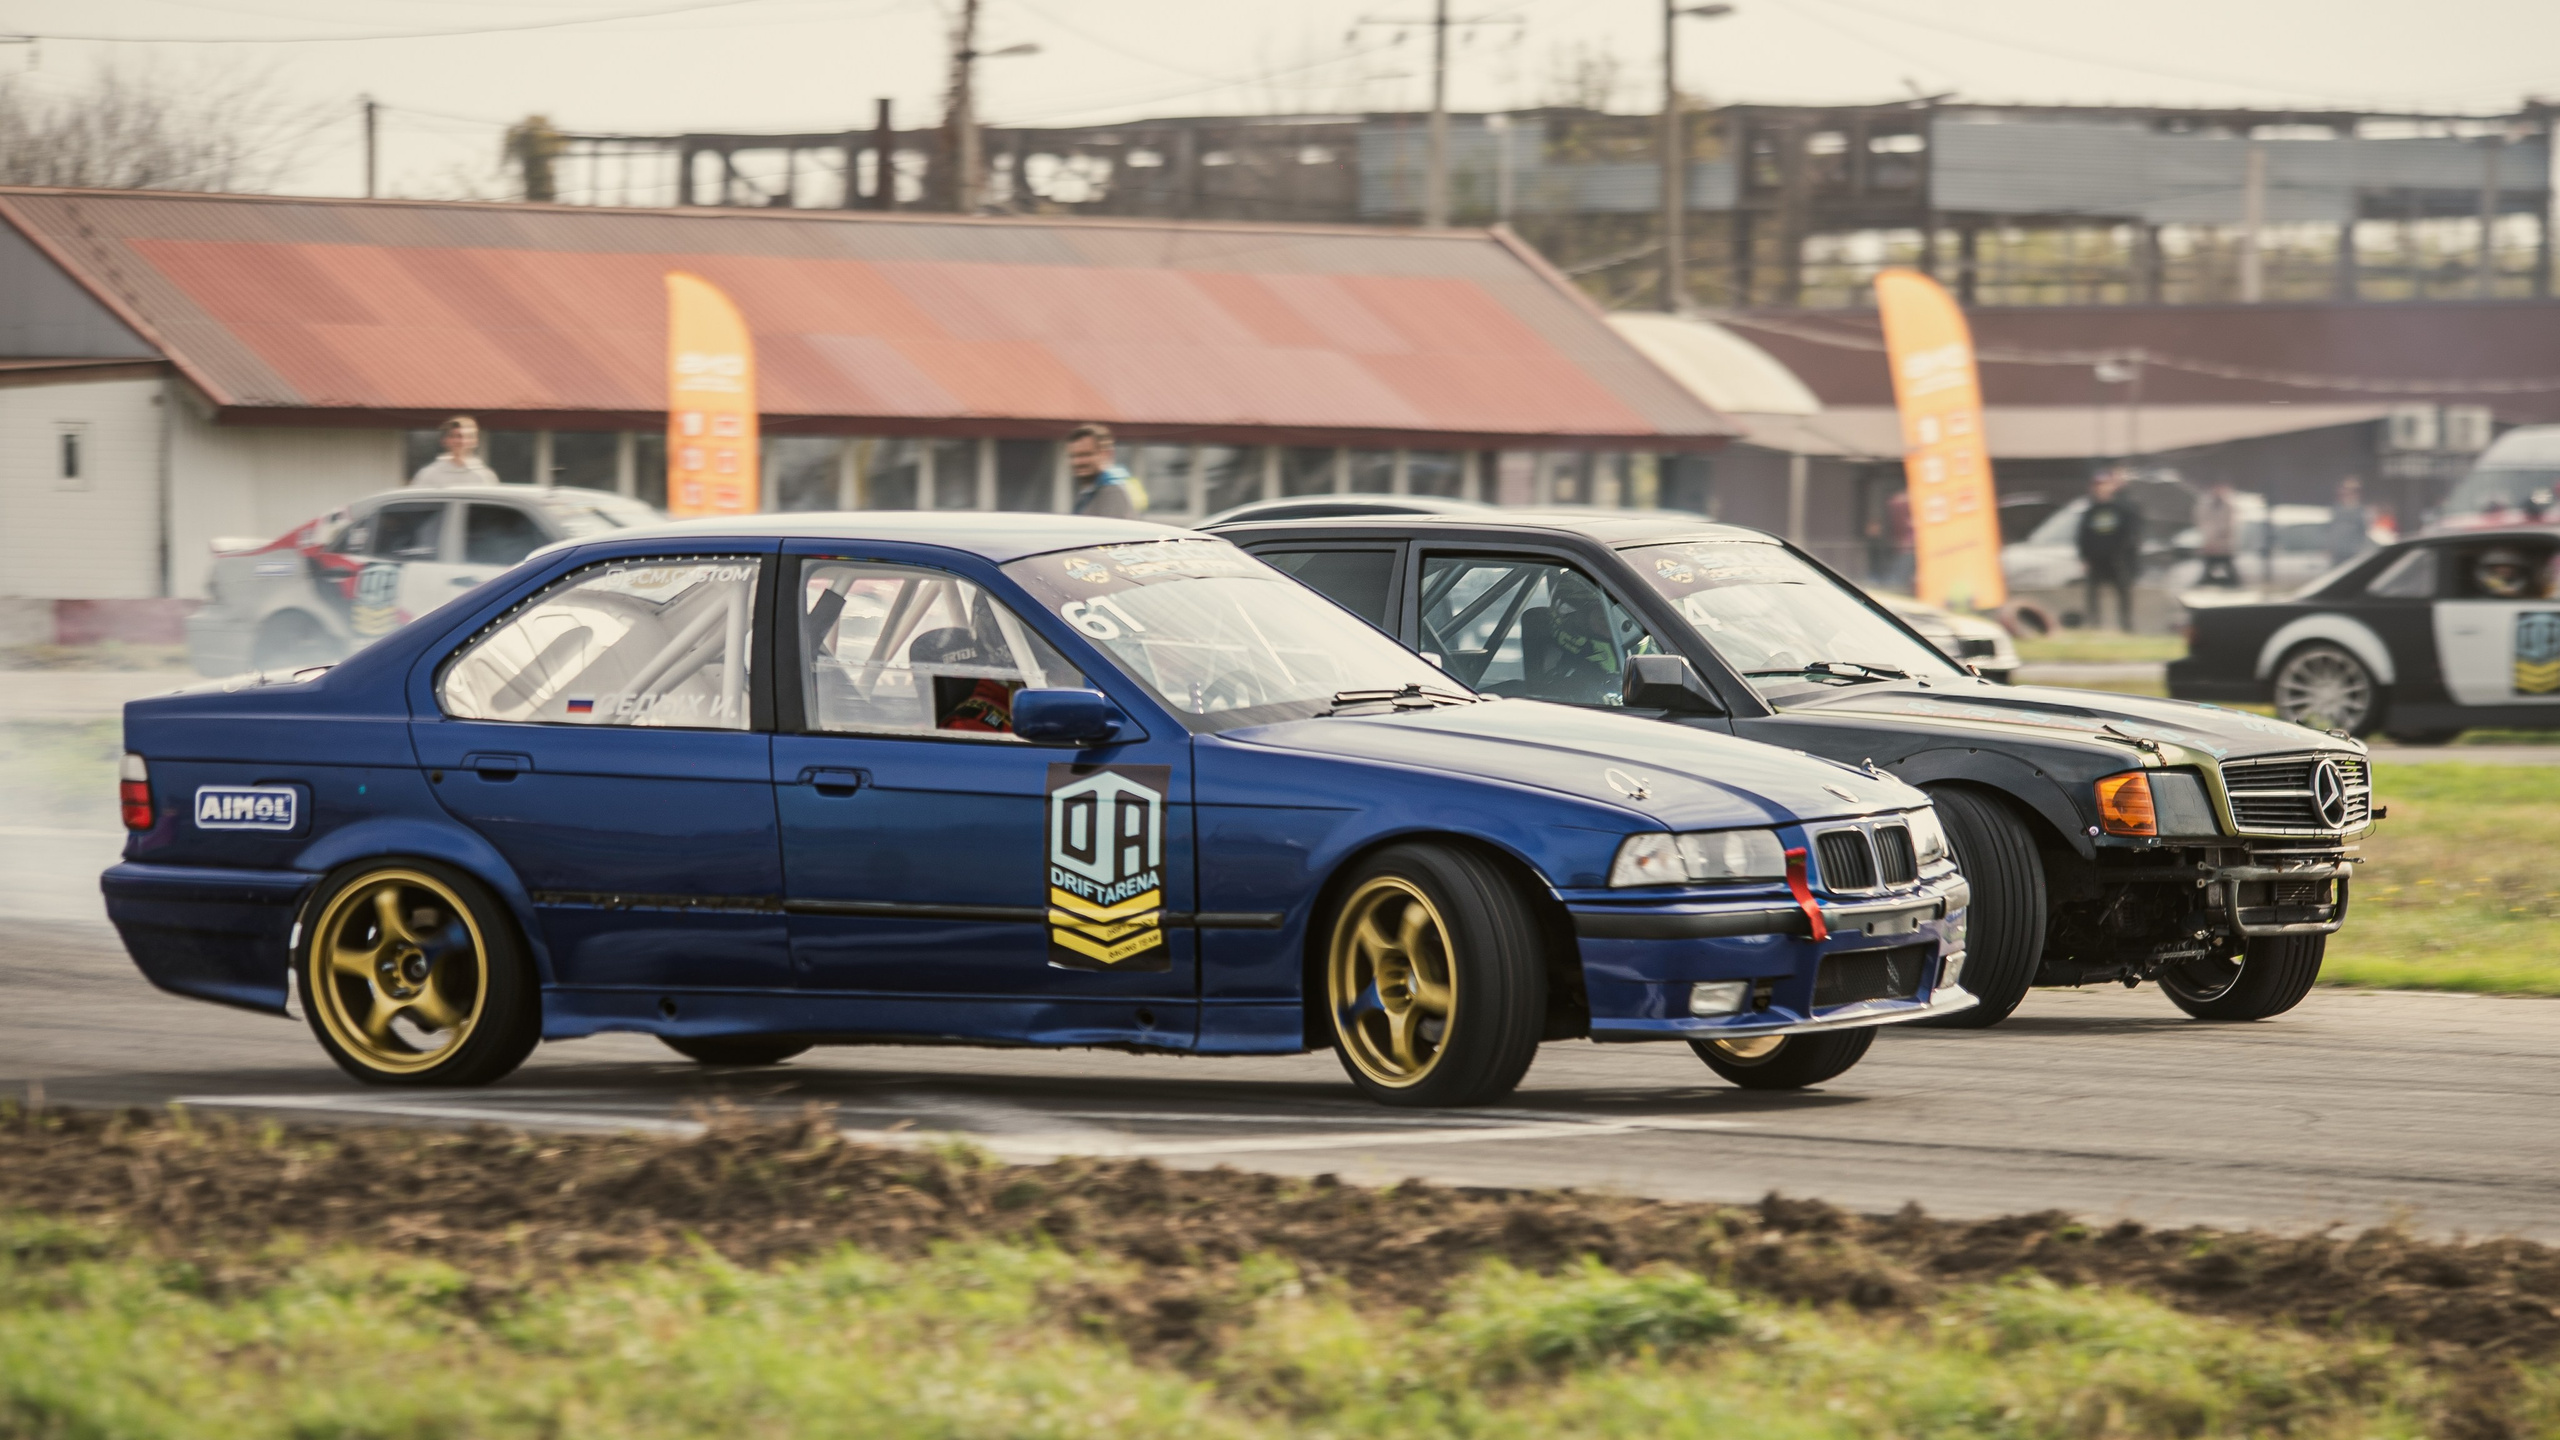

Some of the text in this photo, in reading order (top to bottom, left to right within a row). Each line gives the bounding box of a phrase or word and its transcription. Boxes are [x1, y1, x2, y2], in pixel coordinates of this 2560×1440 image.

[1060, 595, 1146, 640] 61
[200, 795, 290, 821] AIMOL
[1051, 867, 1160, 905] DRIFTARENA
